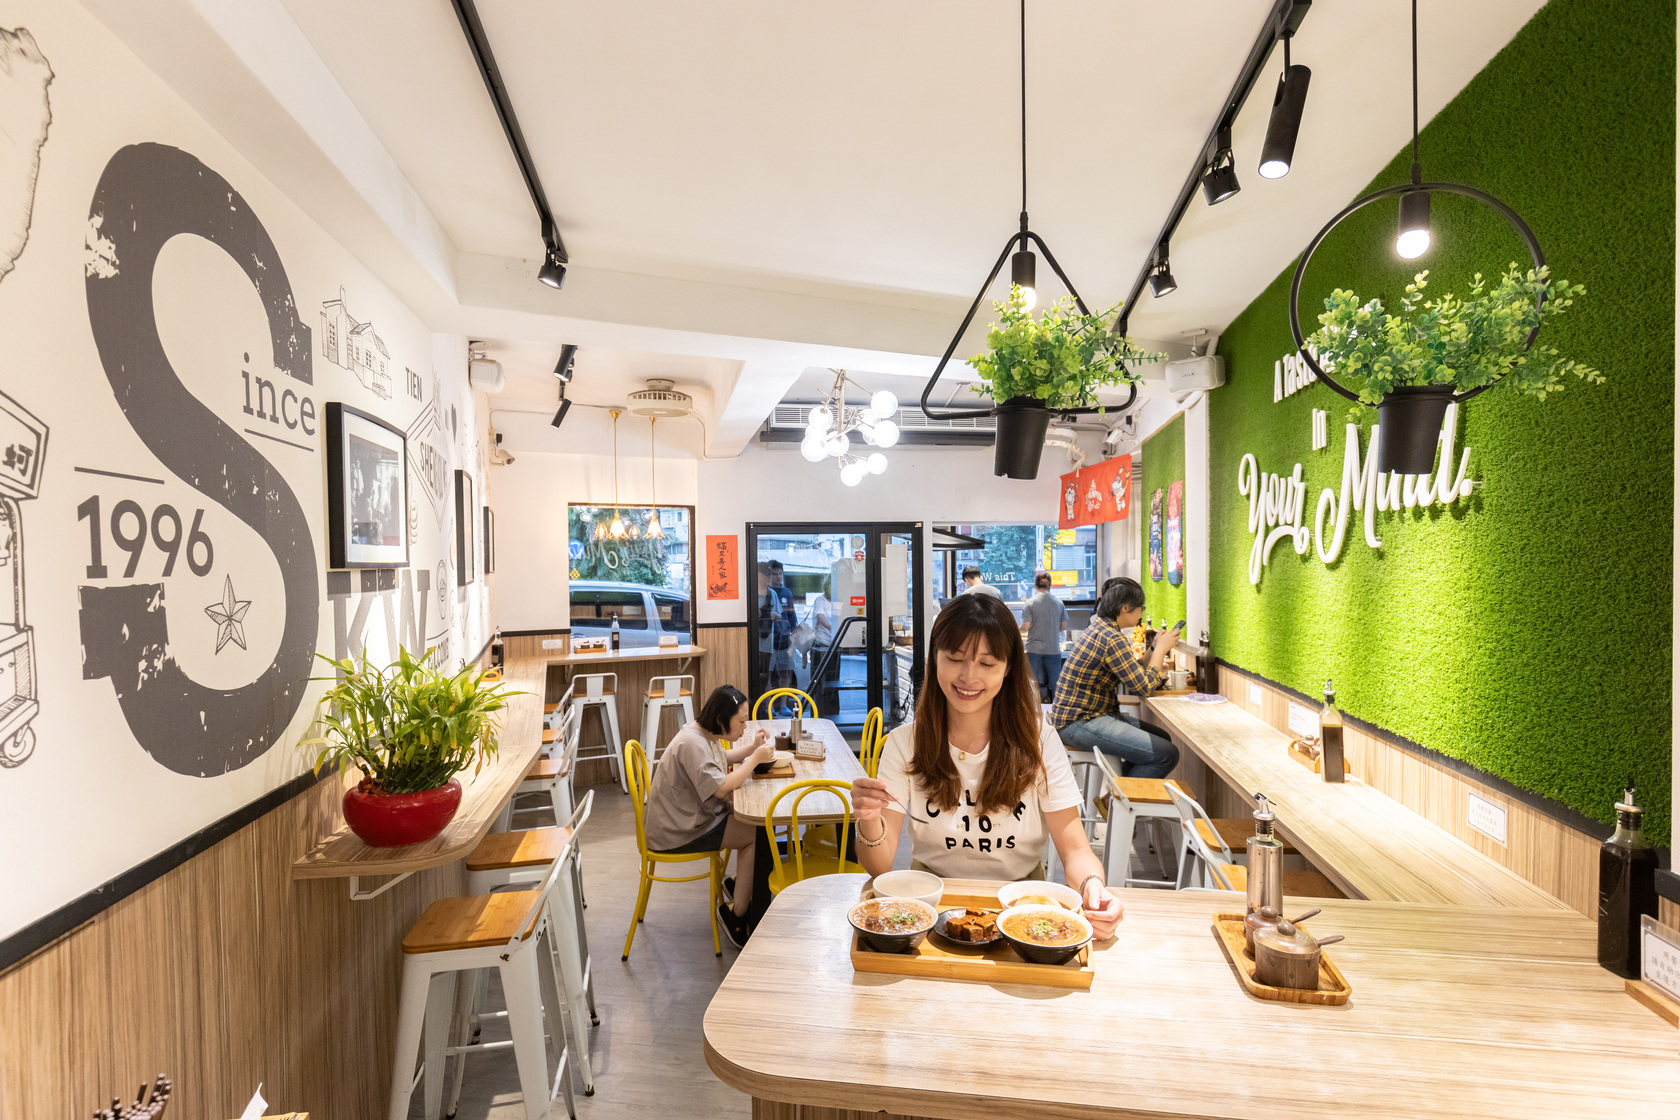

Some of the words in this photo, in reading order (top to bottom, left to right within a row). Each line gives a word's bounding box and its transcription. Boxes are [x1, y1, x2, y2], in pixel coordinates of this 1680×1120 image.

[405, 366, 422, 403] TIEN
[1273, 359, 1283, 403] A
[77, 495, 214, 579] 1996
[1238, 453, 1310, 585] Your
[945, 835, 1016, 853] PARIS
[962, 815, 992, 833] 10
